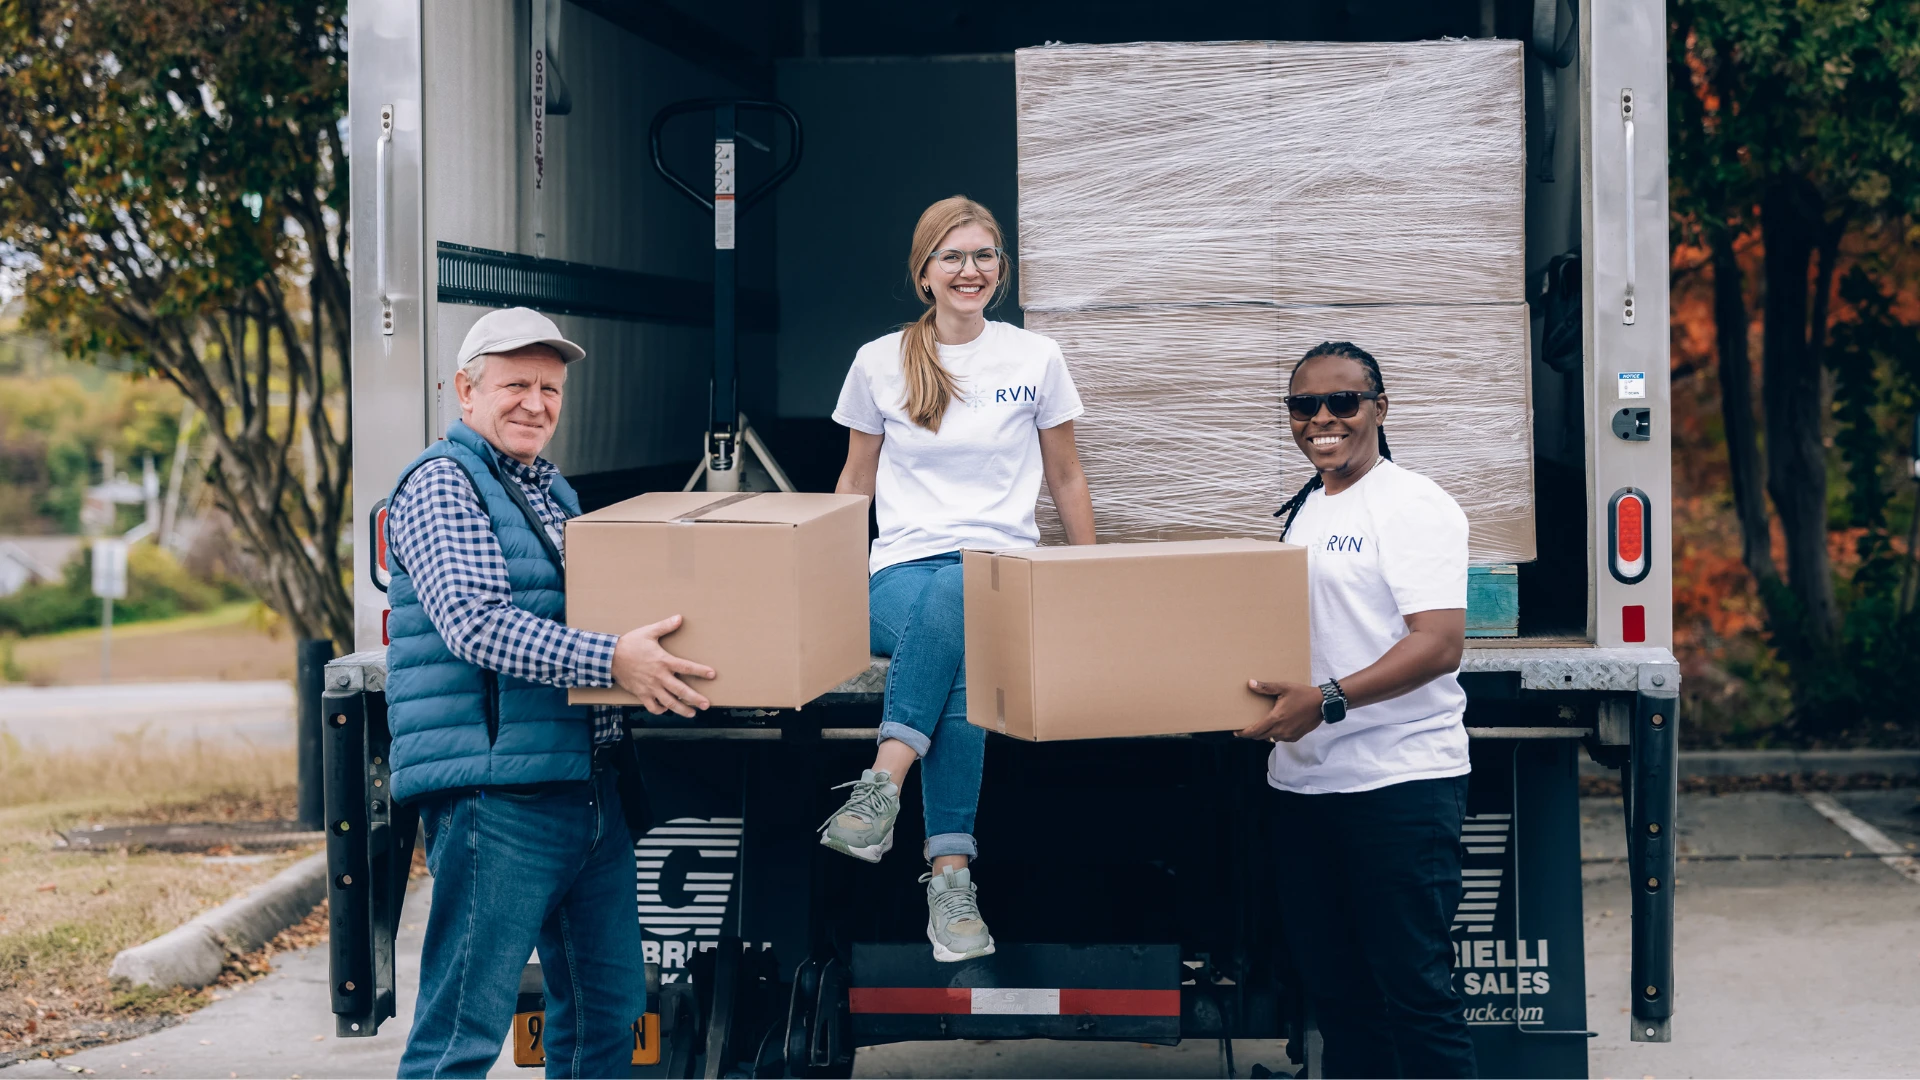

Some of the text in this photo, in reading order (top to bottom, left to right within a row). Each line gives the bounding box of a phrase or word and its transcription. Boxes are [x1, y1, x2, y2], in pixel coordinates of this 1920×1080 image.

[996, 386, 1036, 403] RVN
[1326, 535, 1363, 552] RVN
[1464, 971, 1550, 995] SALES
[1463, 1003, 1544, 1021] uck.com
